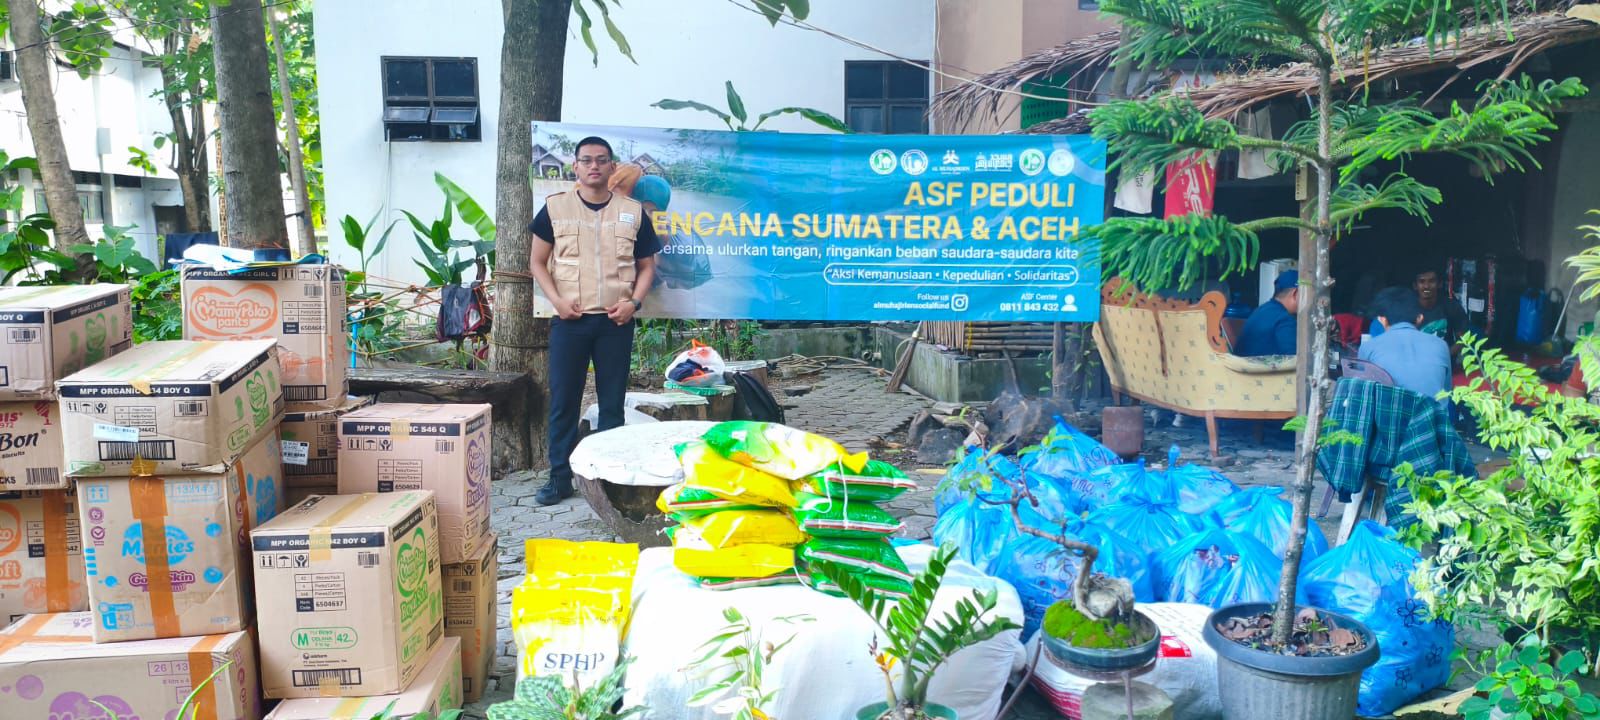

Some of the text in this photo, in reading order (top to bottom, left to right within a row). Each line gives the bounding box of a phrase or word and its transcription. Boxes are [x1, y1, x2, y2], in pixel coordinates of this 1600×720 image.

[904, 181, 1075, 208] ASF PEDULI
[652, 211, 1080, 242] ENCANA SUMATERA & ACEH
[717, 243, 768, 256] ulurkan
[771, 243, 822, 260] tangan,
[825, 245, 892, 261] ringankan
[895, 246, 937, 258] beban
[941, 247, 1052, 259] saudara-saudara
[1055, 247, 1078, 259] kita
[857, 269, 932, 280] Kemanusiaan
[942, 270, 1004, 283] Kepedulian
[1000, 302, 1059, 312] 0811 843 432
[343, 537, 359, 545] BOY
[298, 632, 309, 647] M
[336, 633, 349, 643] 42
[154, 663, 167, 672] 26
[544, 652, 605, 671] SPHP
